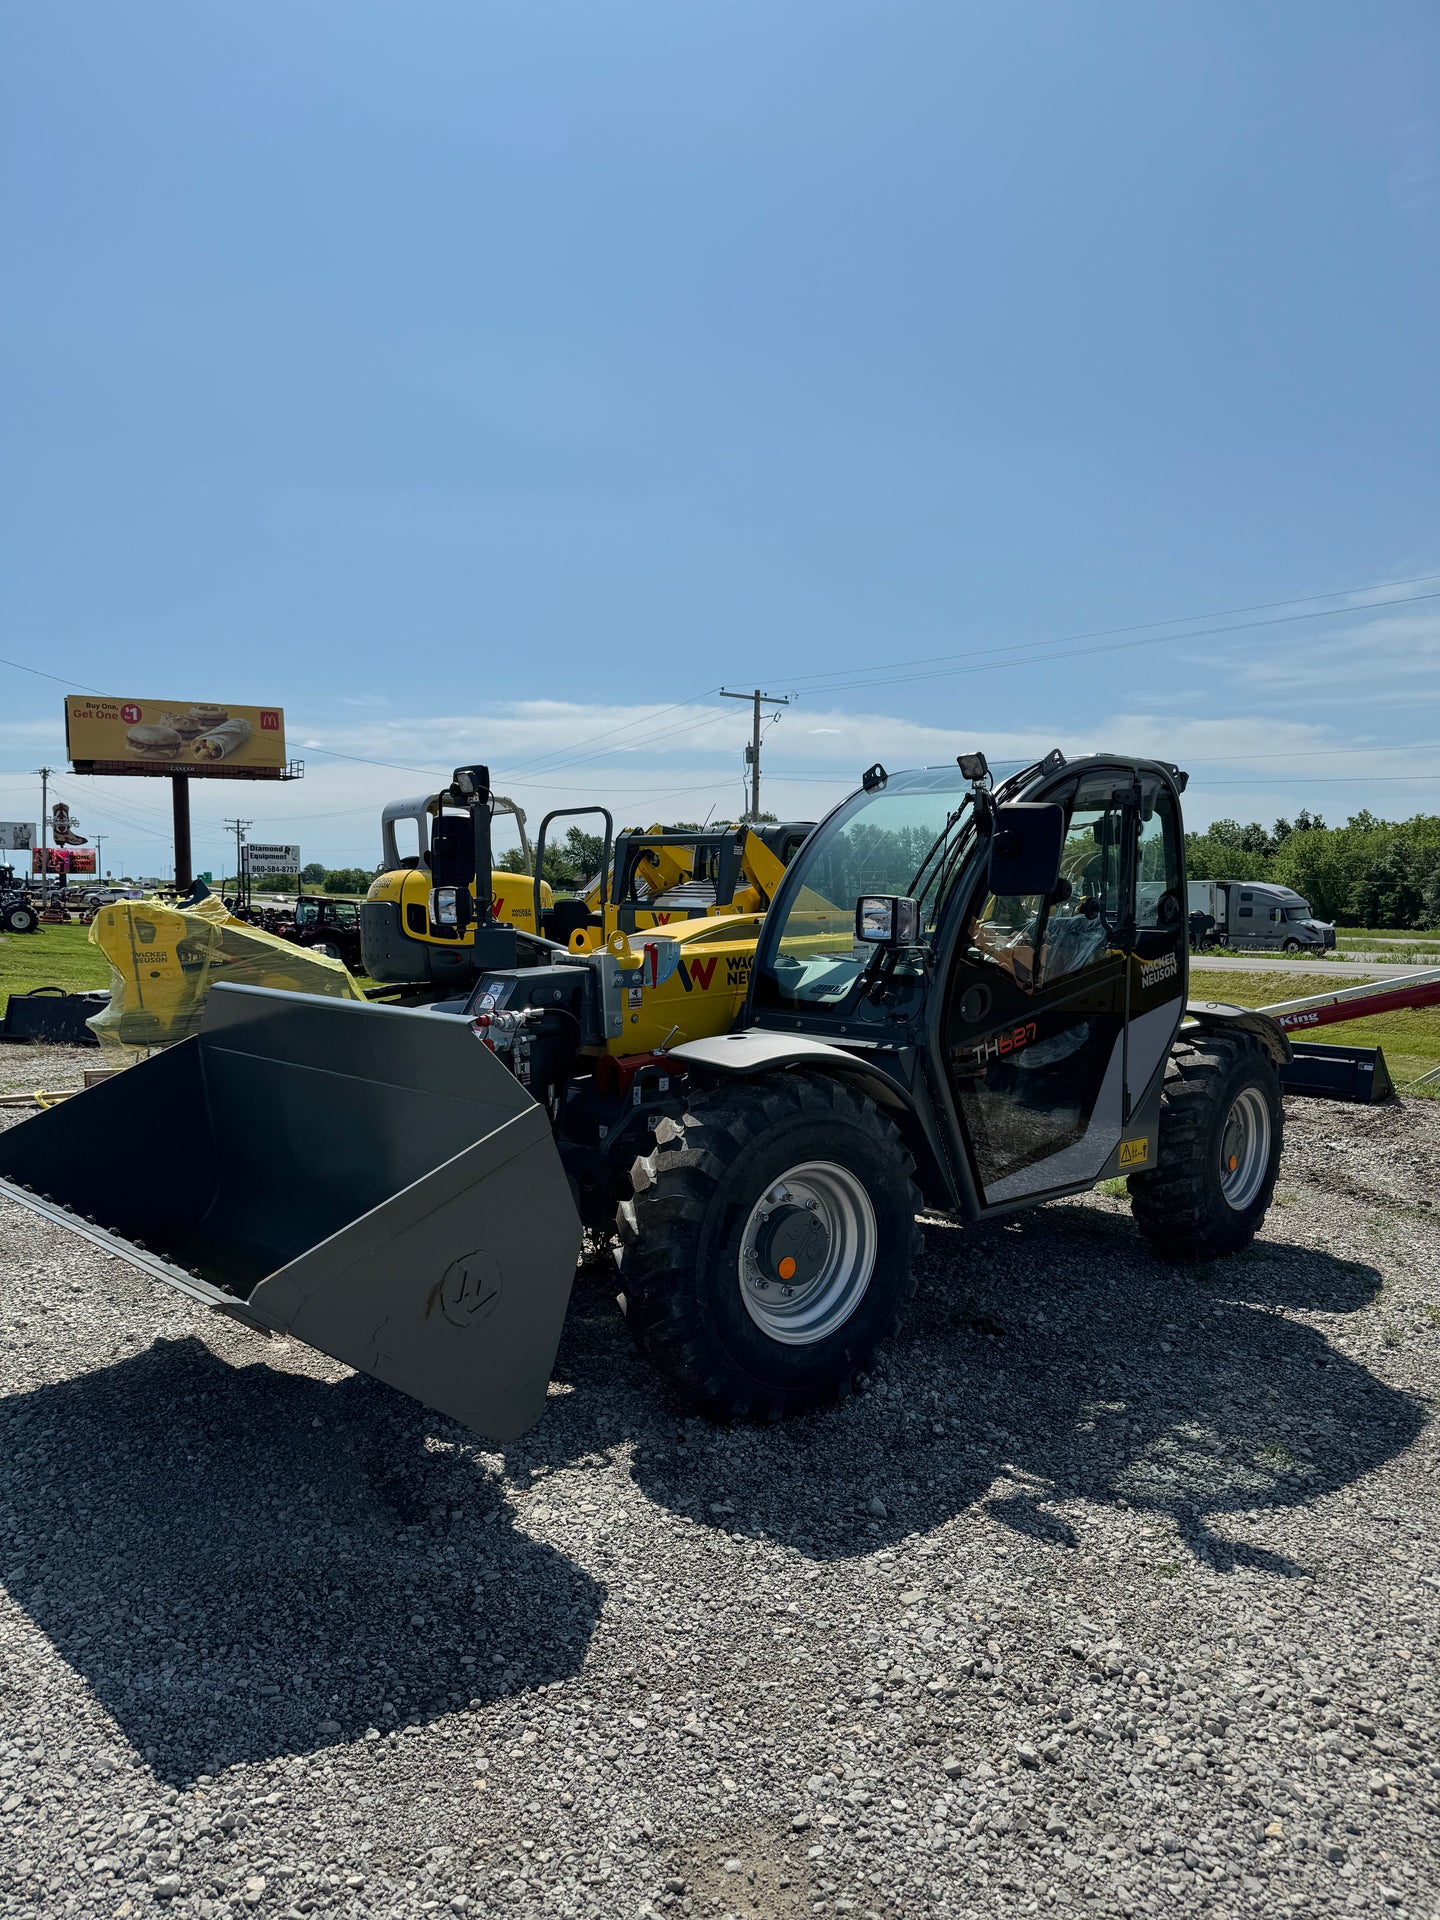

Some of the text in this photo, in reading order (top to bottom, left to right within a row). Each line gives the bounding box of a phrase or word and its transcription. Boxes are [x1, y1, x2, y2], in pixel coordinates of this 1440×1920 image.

[86, 702, 119, 711] Buy One,
[73, 710, 118, 720] Get One
[249, 845, 283, 853] Diamond
[249, 852, 287, 860] Equipment
[252, 865, 298, 873] 660-584-8757
[1140, 951, 1176, 977] WACKER
[1141, 963, 1178, 989] NEUSON
[1280, 1012, 1319, 1026] King
[972, 1022, 1037, 1065] TH627
